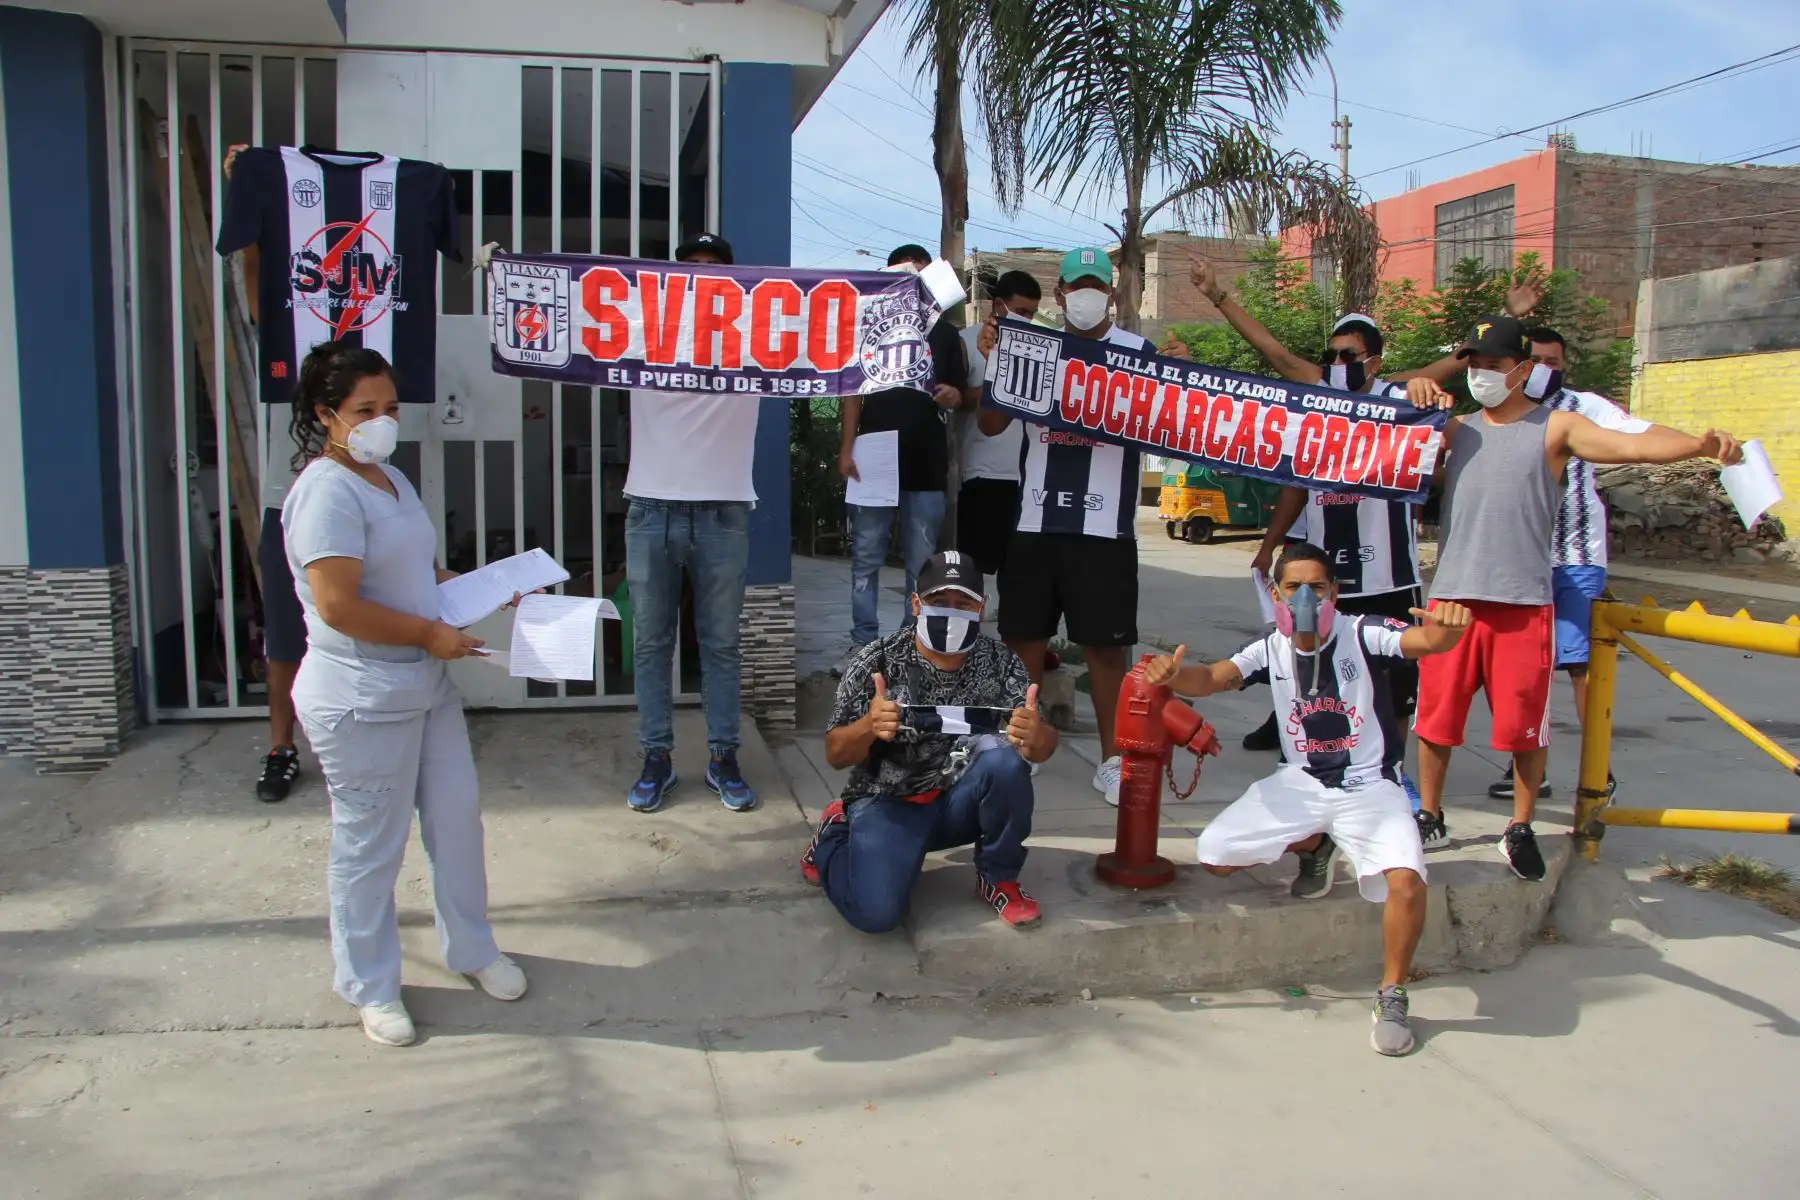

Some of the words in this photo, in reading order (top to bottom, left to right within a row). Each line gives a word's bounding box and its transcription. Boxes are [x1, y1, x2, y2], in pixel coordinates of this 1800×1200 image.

[289, 249, 402, 298] SJM
[499, 263, 561, 279] ALIANZA
[557, 294, 568, 334] LIMA
[579, 265, 860, 374] SVRCO
[1007, 331, 1053, 349] ALIANZA
[519, 350, 543, 363] 1901
[607, 367, 633, 385] EL
[639, 370, 727, 392] PVEBLO
[733, 376, 763, 393] DE
[769, 377, 828, 394] 1993
[868, 360, 929, 382] SVRCO
[1044, 360, 1055, 390] LIMA
[1105, 350, 1158, 377] VILLA
[1161, 365, 1183, 384] EL
[1187, 371, 1288, 404] SALVADOR
[1302, 393, 1354, 414] CONO
[1356, 402, 1398, 421] SVR
[1012, 396, 1030, 409] 1901
[1059, 357, 1288, 472] COCHARCAS
[1291, 411, 1434, 493] GRONE
[1031, 488, 1104, 511] VES
[1294, 733, 1360, 753] GRONE
